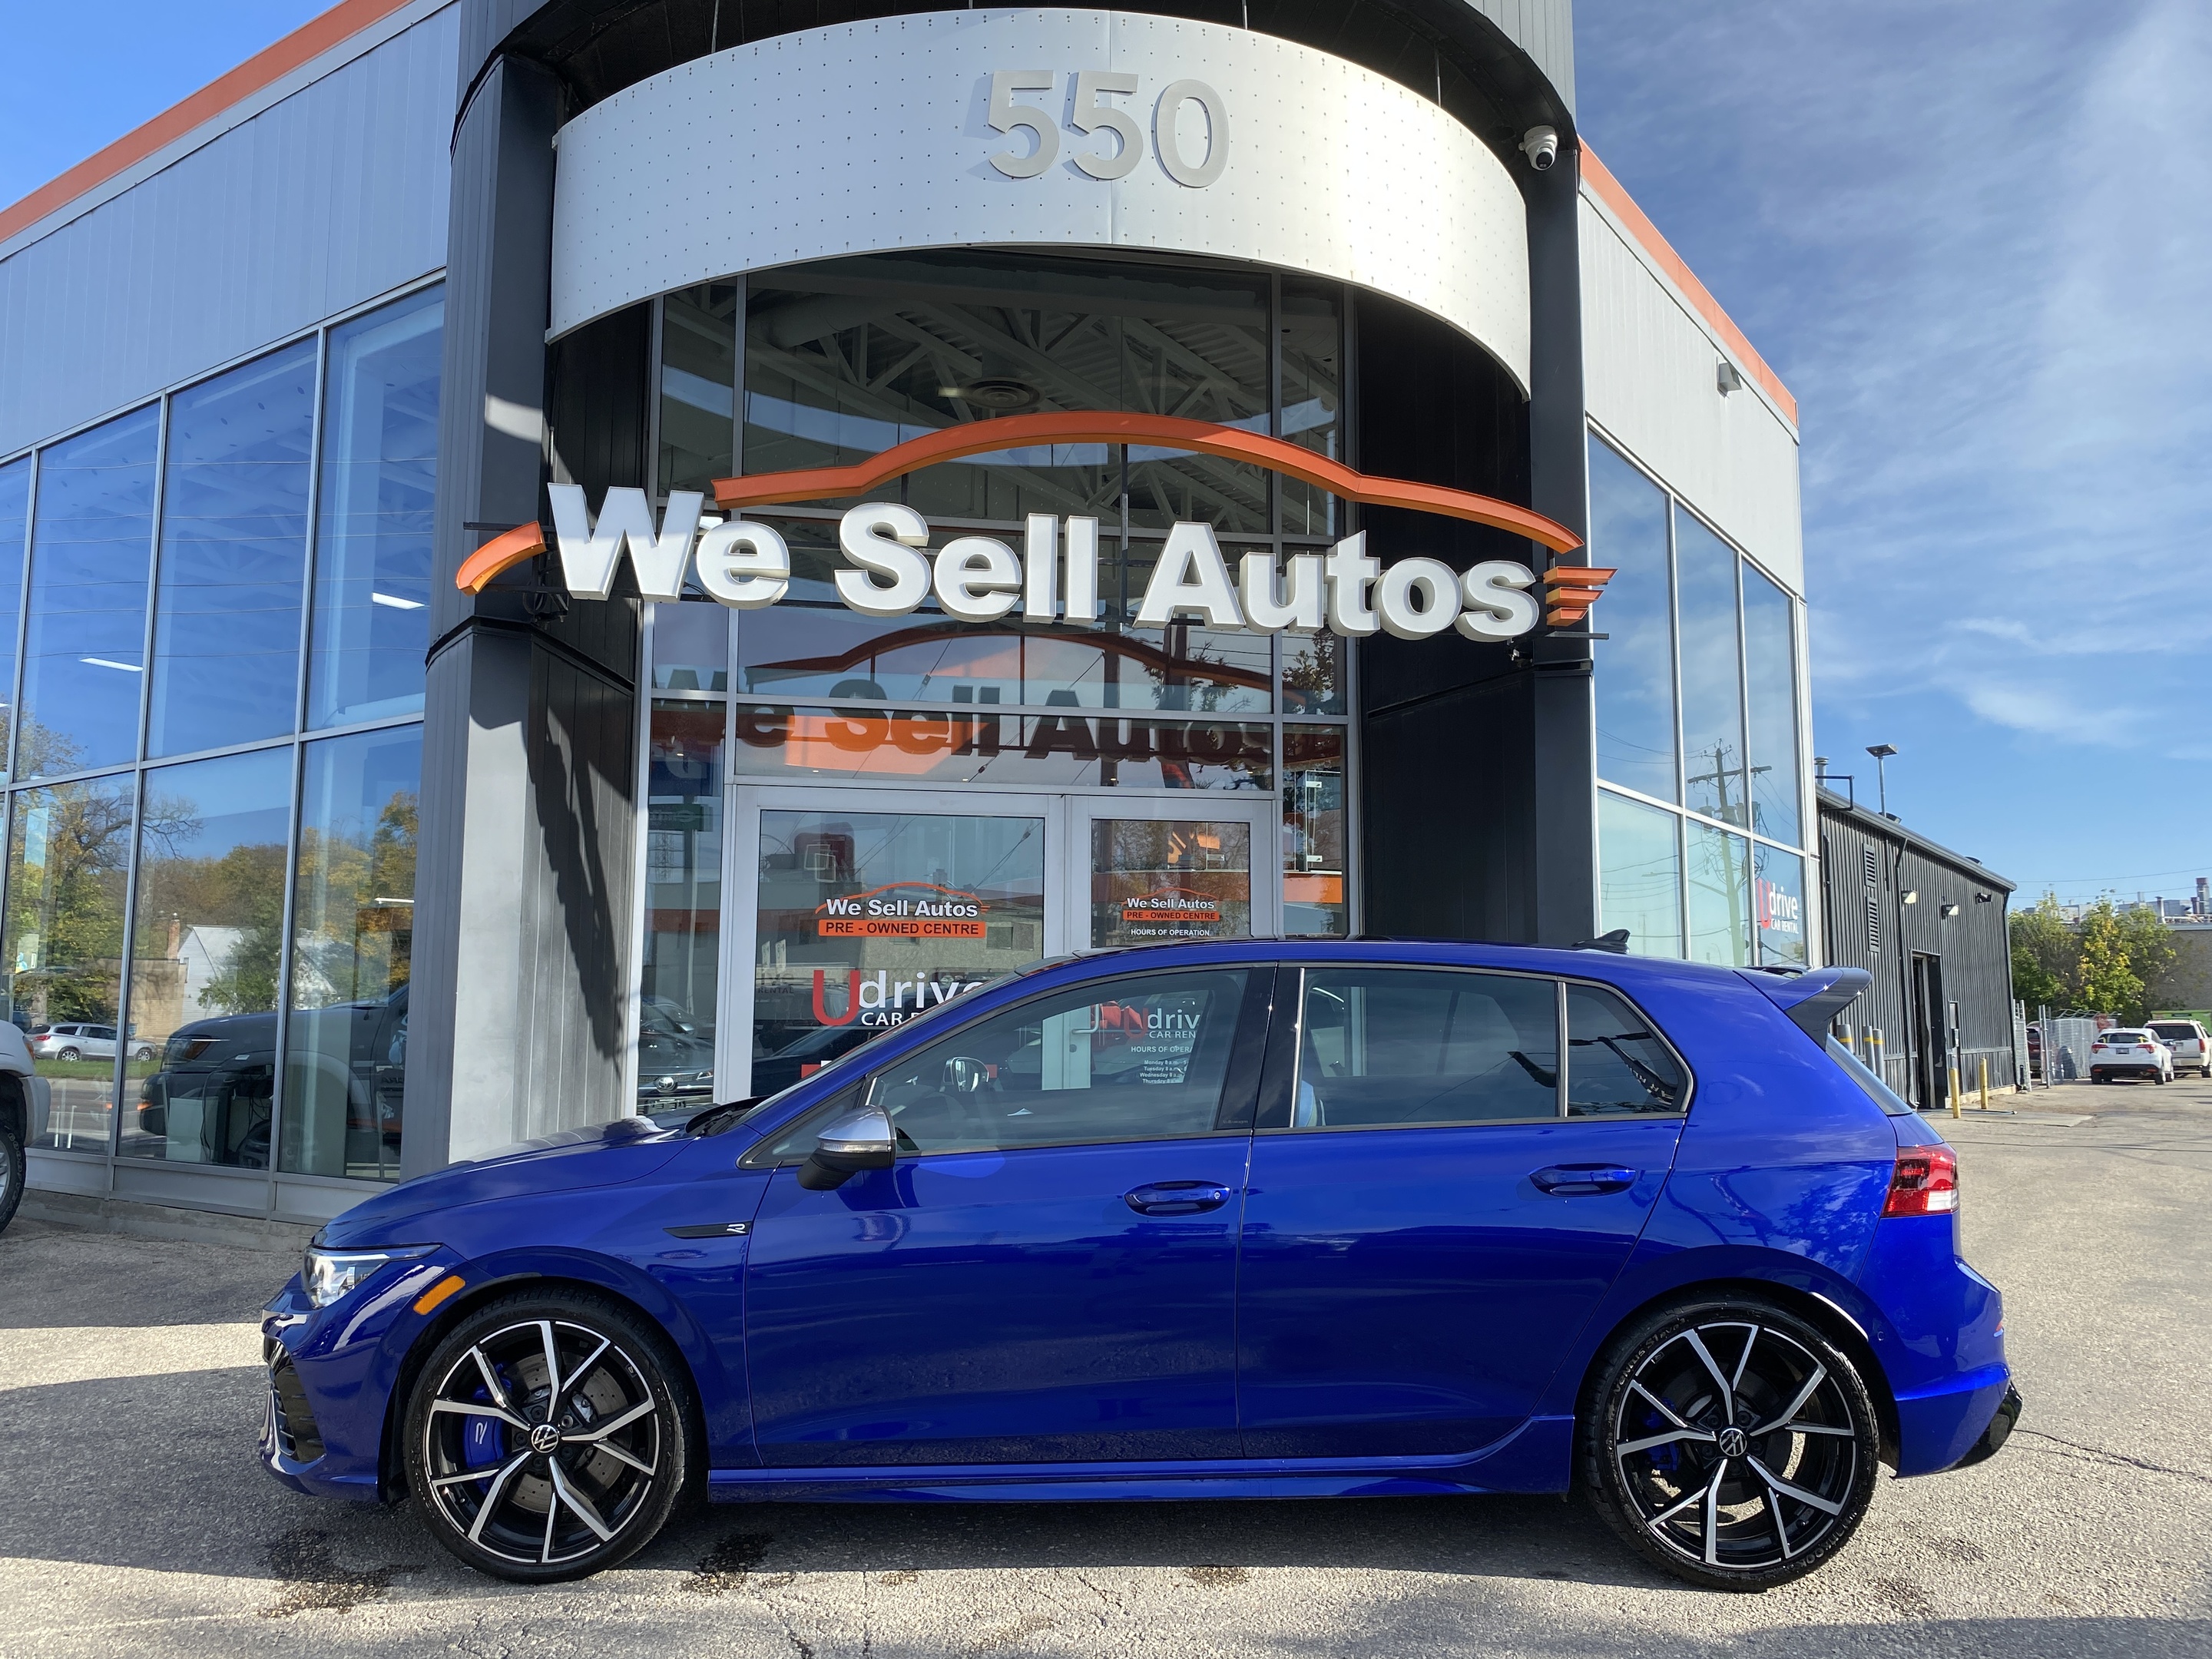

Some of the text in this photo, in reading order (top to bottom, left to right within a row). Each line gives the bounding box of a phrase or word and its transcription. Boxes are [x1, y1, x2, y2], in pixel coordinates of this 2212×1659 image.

[988, 70, 1230, 189] 550
[548, 482, 1539, 643] We Sell Autos
[826, 898, 979, 918] We Sell Autos
[1127, 897, 1214, 909] We Sell Autos
[1757, 879, 1798, 929] Udrive
[826, 922, 854, 933] PRE
[867, 922, 919, 934] OWNED
[924, 923, 979, 935] CENTRE
[1771, 919, 1799, 934] CAR RENTAL
[813, 970, 984, 1025] Udriv
[861, 1012, 902, 1025] CAR
[1149, 1030, 1171, 1038] CAR
